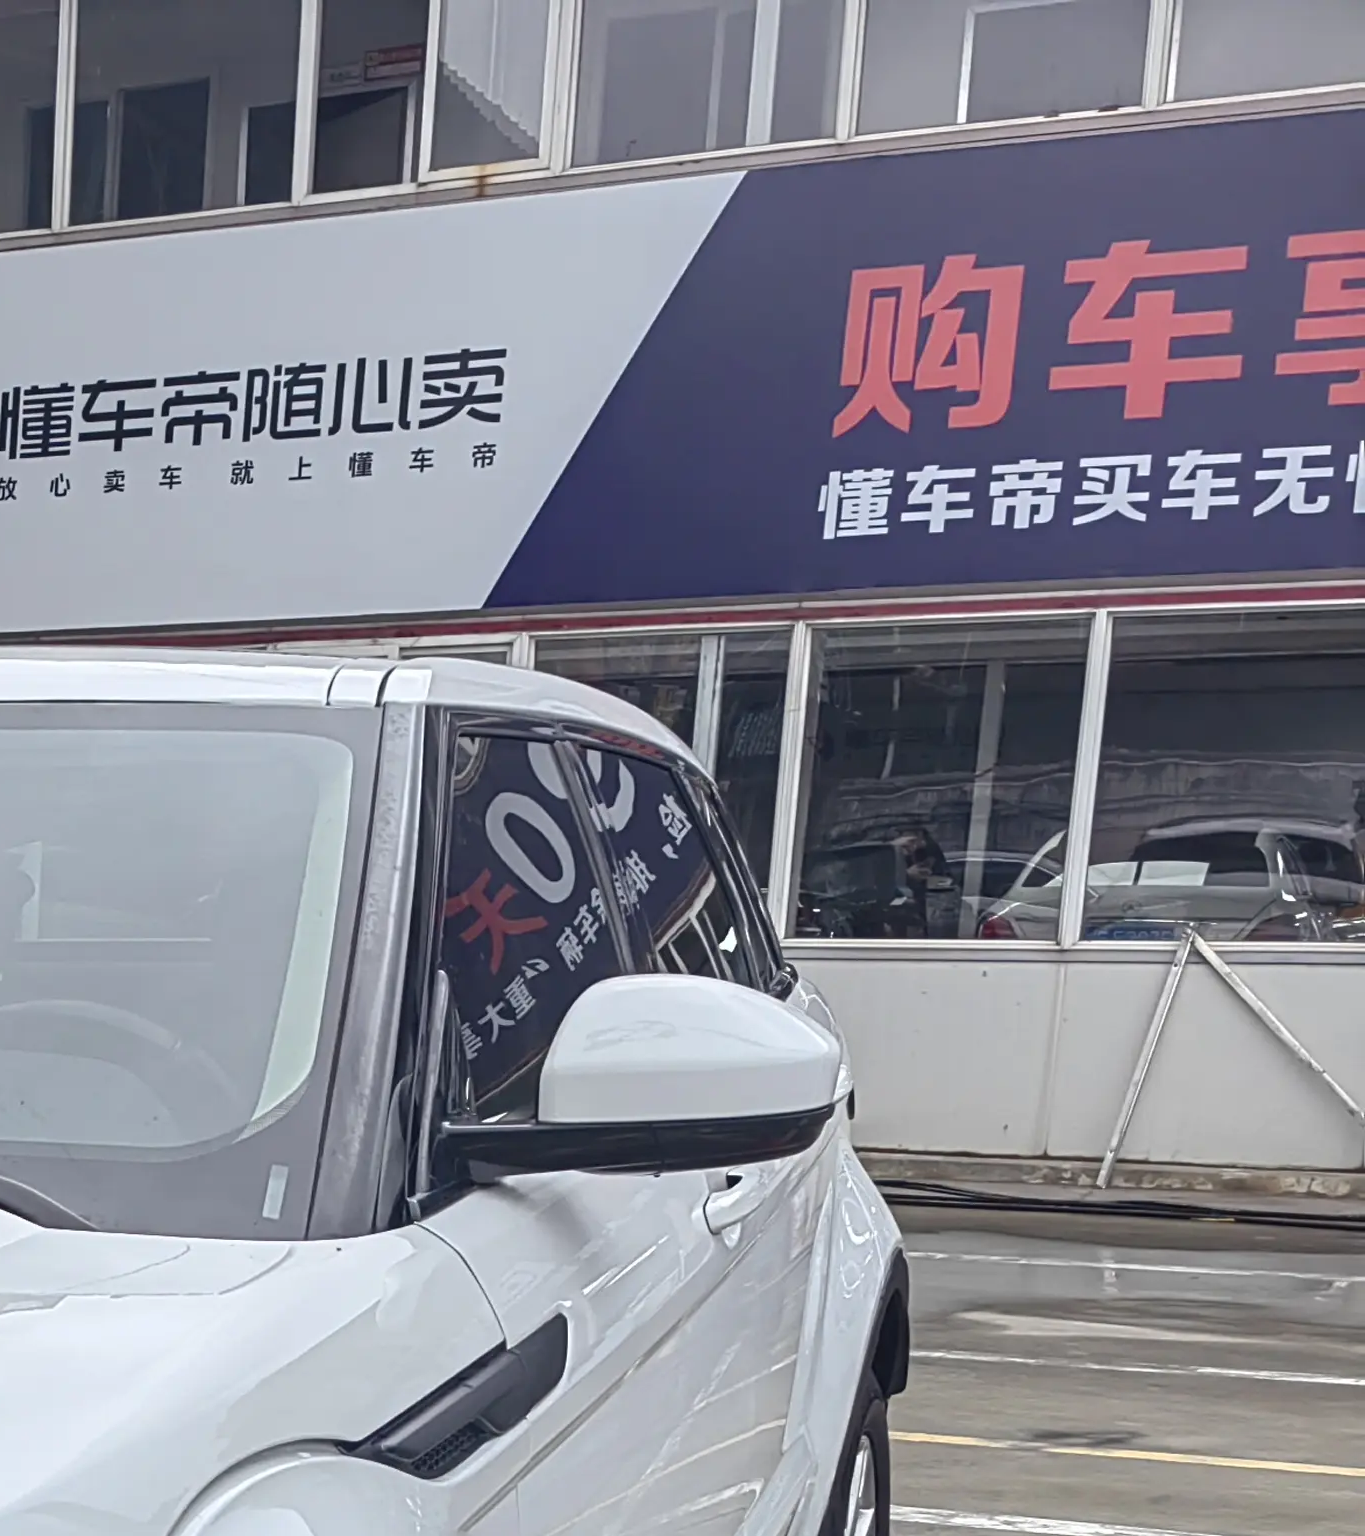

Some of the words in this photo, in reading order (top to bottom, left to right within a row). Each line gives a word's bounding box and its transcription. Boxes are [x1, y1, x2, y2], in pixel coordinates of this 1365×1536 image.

[817, 440, 1365, 540] 懂车帝买车无
